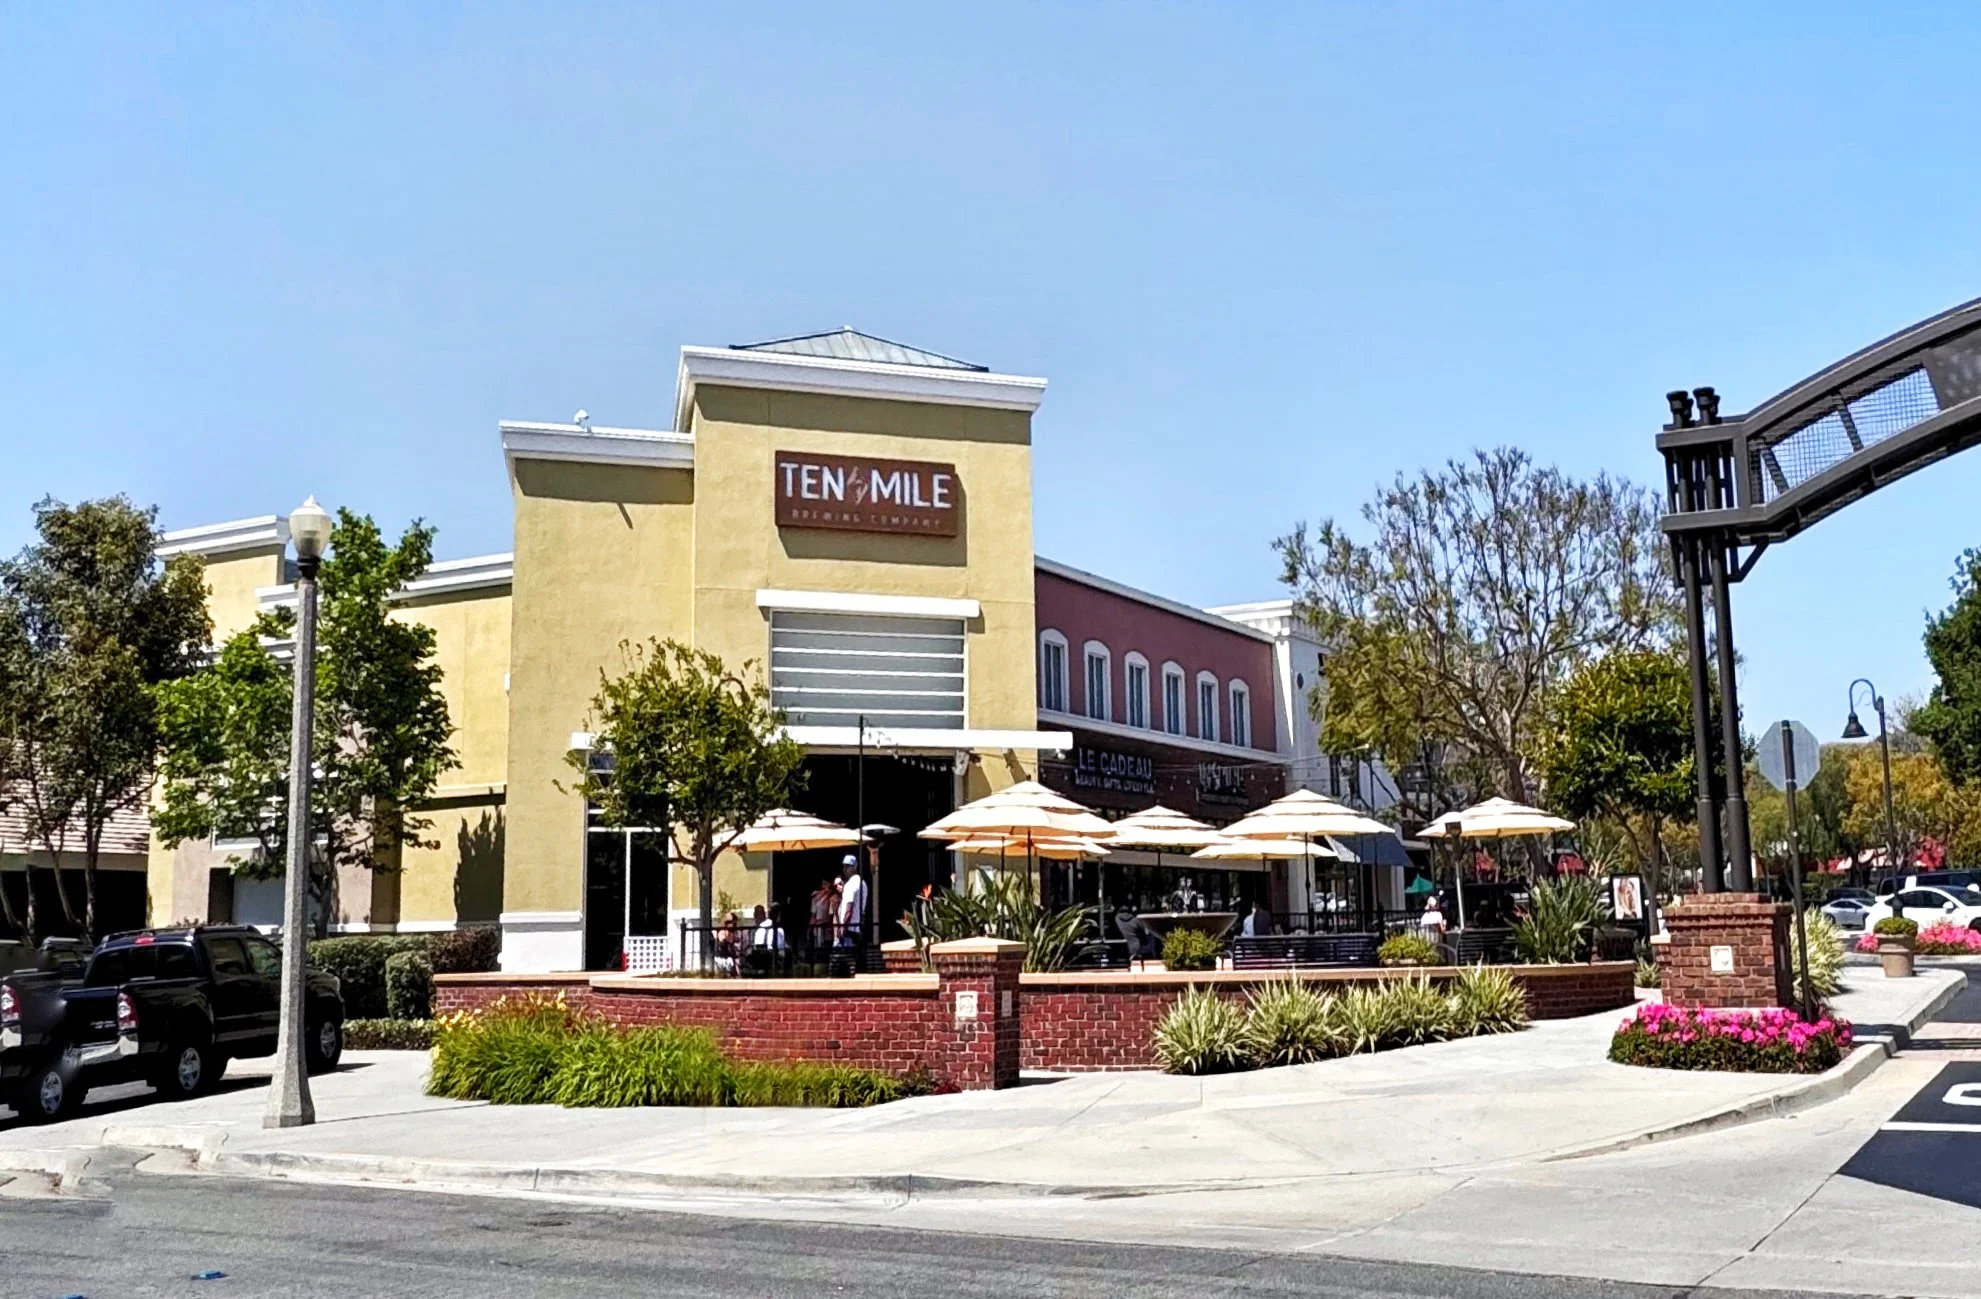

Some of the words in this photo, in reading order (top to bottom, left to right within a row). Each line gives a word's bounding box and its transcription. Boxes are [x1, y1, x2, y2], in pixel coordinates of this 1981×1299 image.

[779, 462, 845, 501] TEN
[871, 469, 952, 508] MILE
[1079, 748, 1096, 771] LE
[1100, 752, 1152, 779] CADEAU
